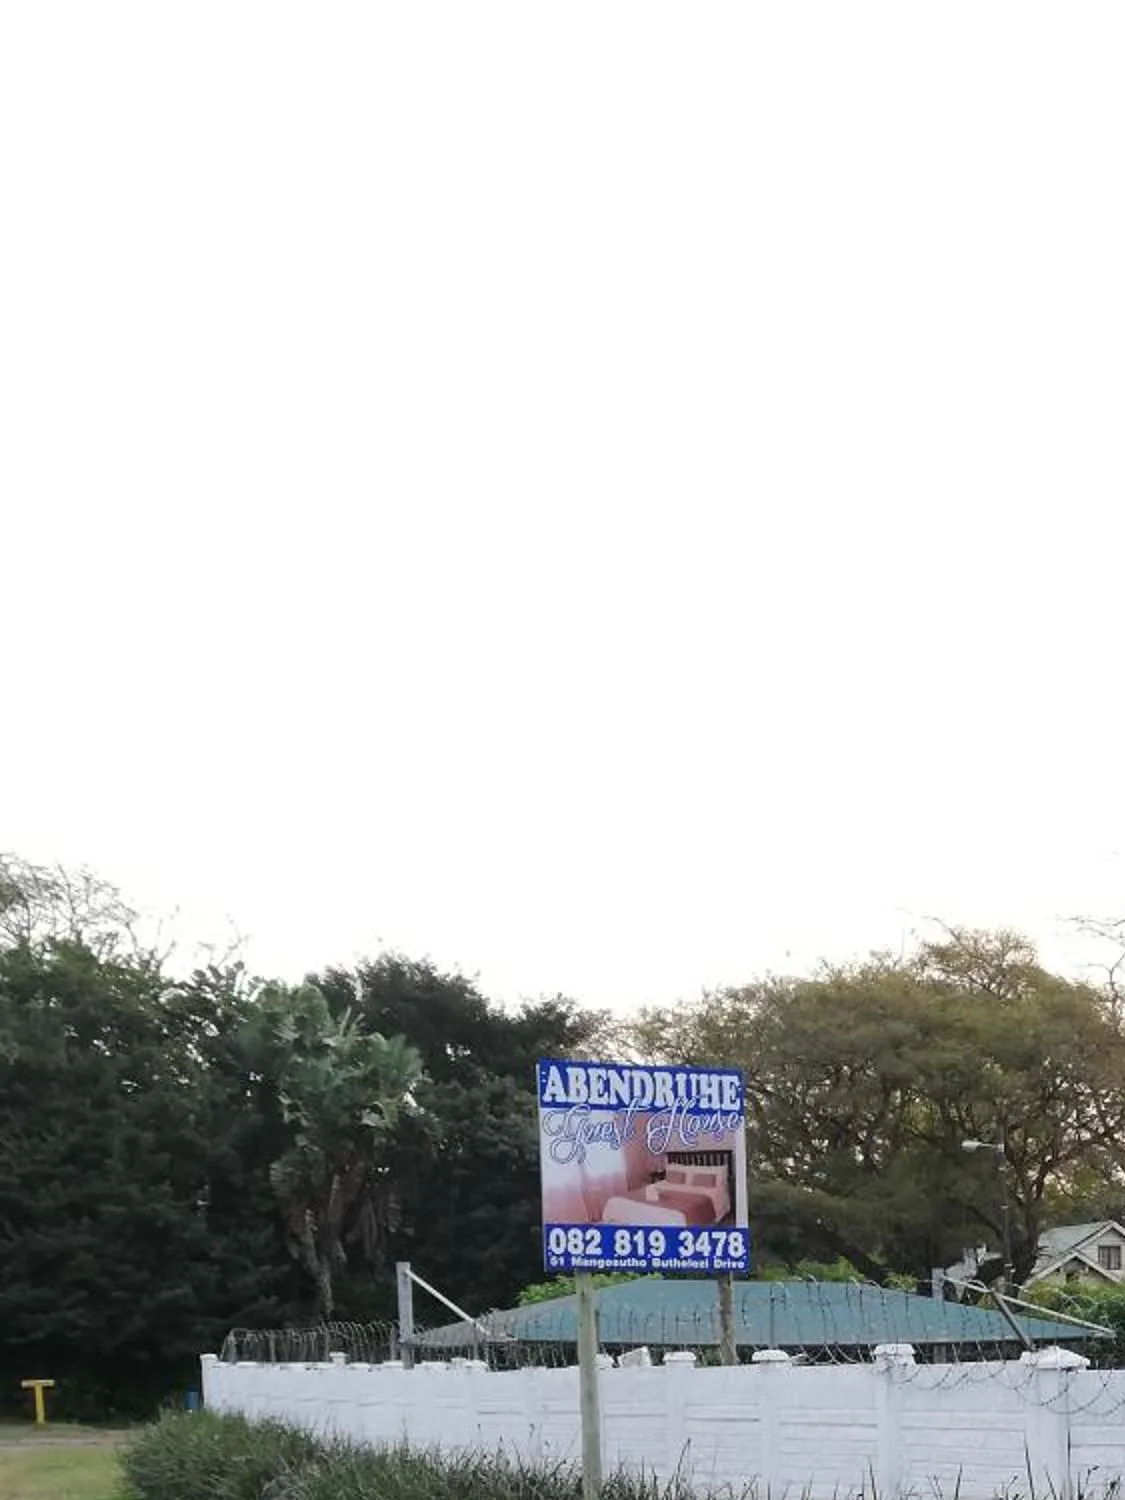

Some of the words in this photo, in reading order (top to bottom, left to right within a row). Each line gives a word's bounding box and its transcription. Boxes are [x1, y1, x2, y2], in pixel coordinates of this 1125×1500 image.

[543, 1065, 741, 1110] ABENDRUHE
[543, 1103, 650, 1164] Guest
[646, 1098, 743, 1154] House
[550, 1228, 603, 1255] 082
[615, 1229, 666, 1256] 819
[678, 1231, 744, 1258] 3478
[714, 1258, 745, 1268] Drive
